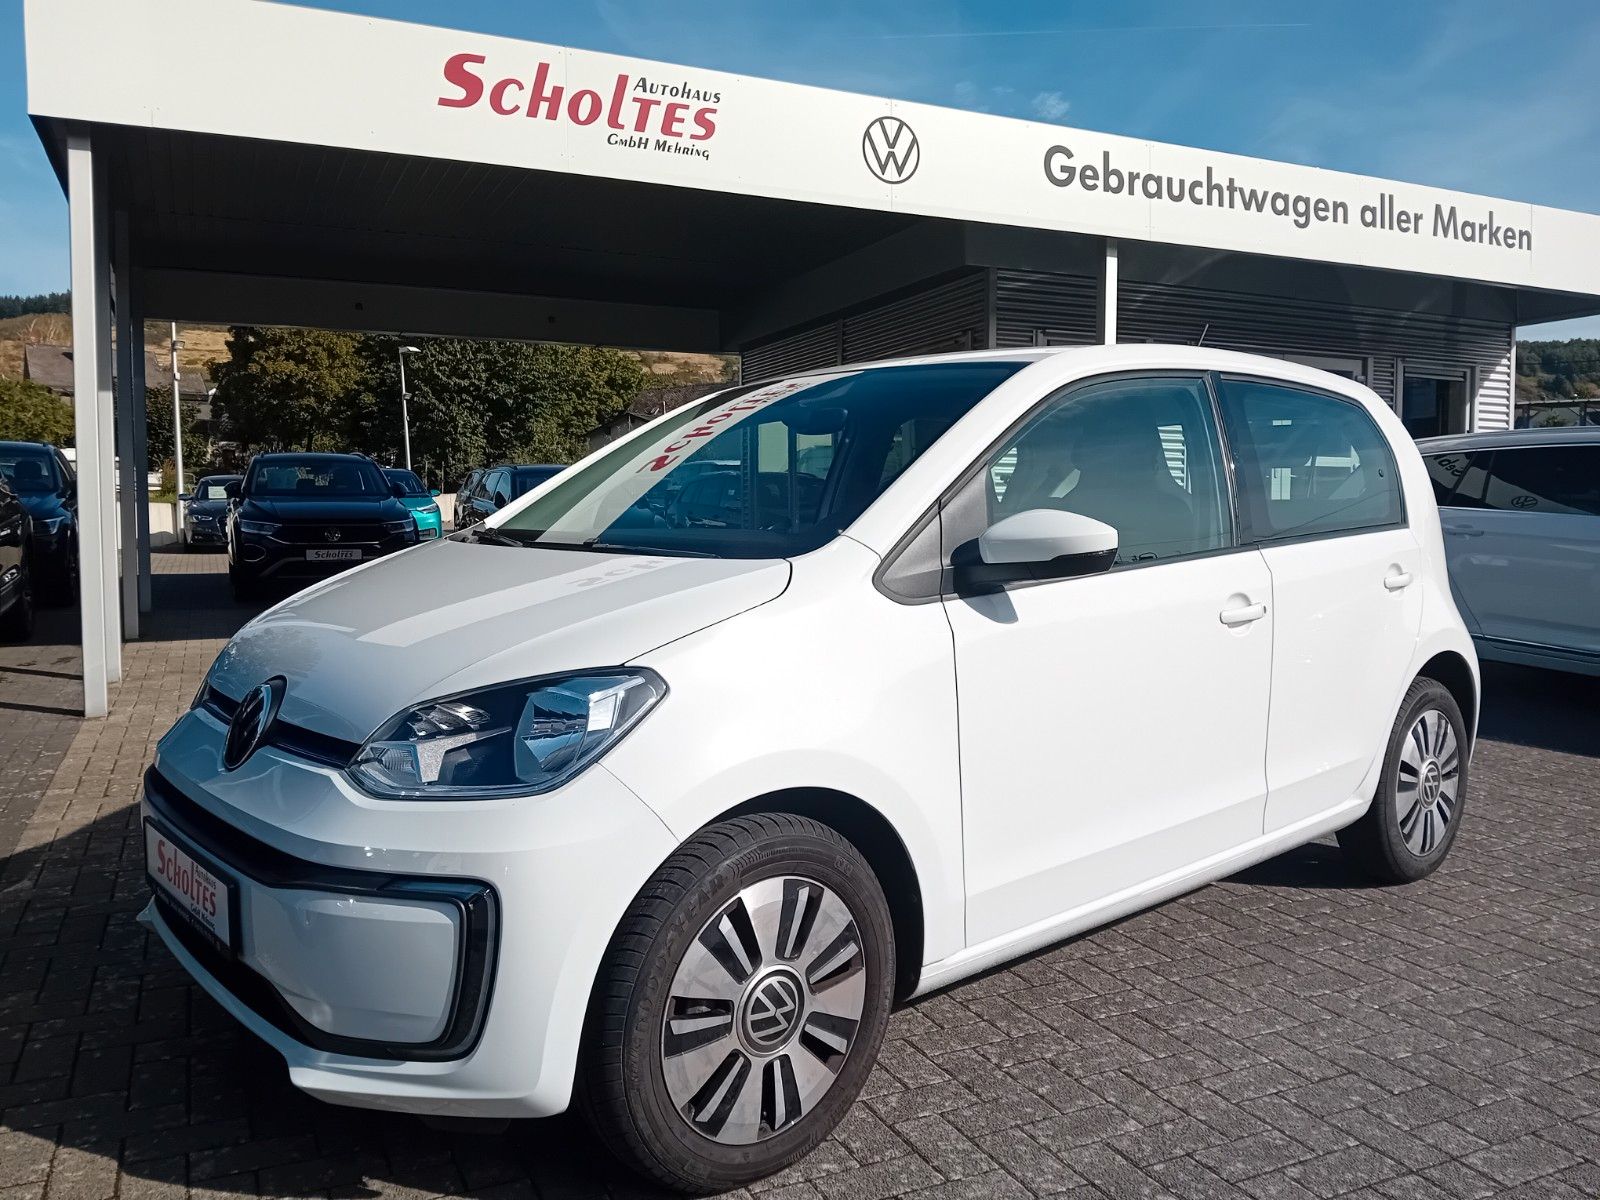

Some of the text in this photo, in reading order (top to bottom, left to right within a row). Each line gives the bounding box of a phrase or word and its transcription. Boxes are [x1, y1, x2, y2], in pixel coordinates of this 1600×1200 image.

[1044, 145, 1532, 251] Gebrauchtwagen aller Marken
